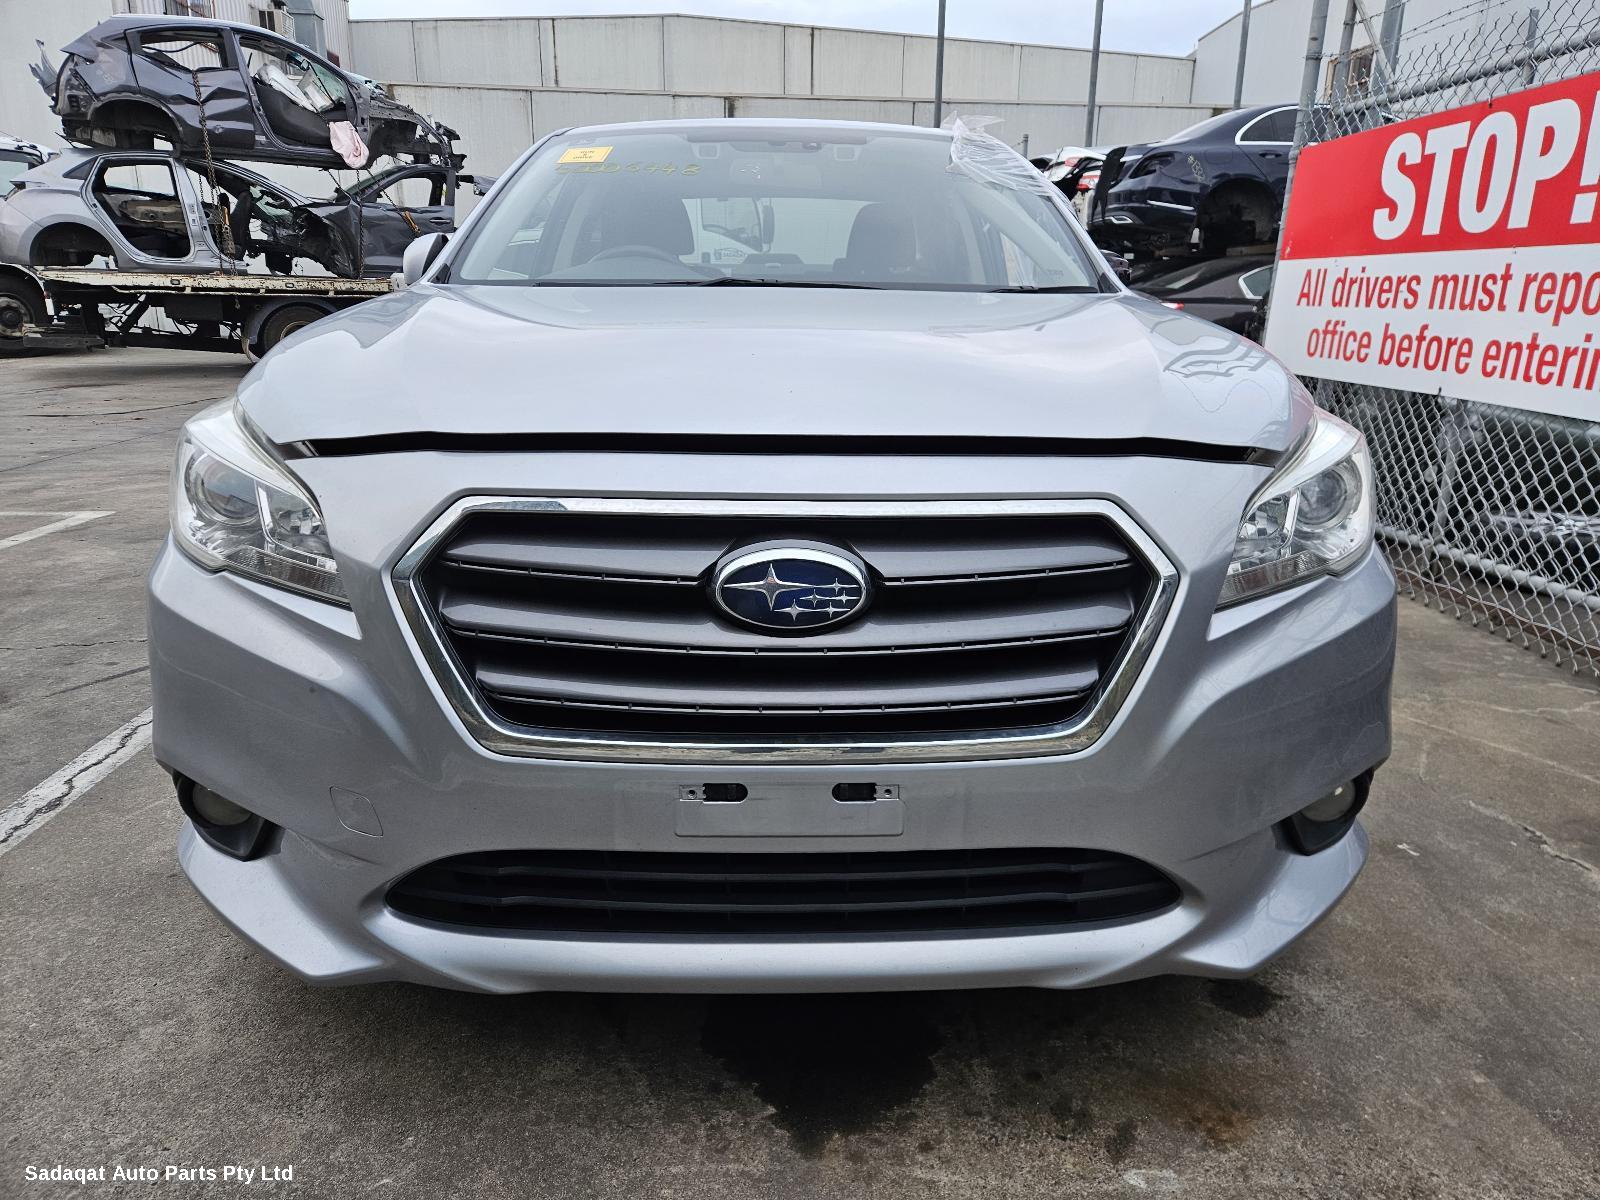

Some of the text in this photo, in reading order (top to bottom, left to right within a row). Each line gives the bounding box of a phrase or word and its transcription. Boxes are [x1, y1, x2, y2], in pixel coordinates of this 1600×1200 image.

[1372, 90, 1600, 241] STOP!
[1296, 262, 1600, 327] All drivers must repo
[1306, 319, 1372, 364] office
[1377, 322, 1474, 375] before
